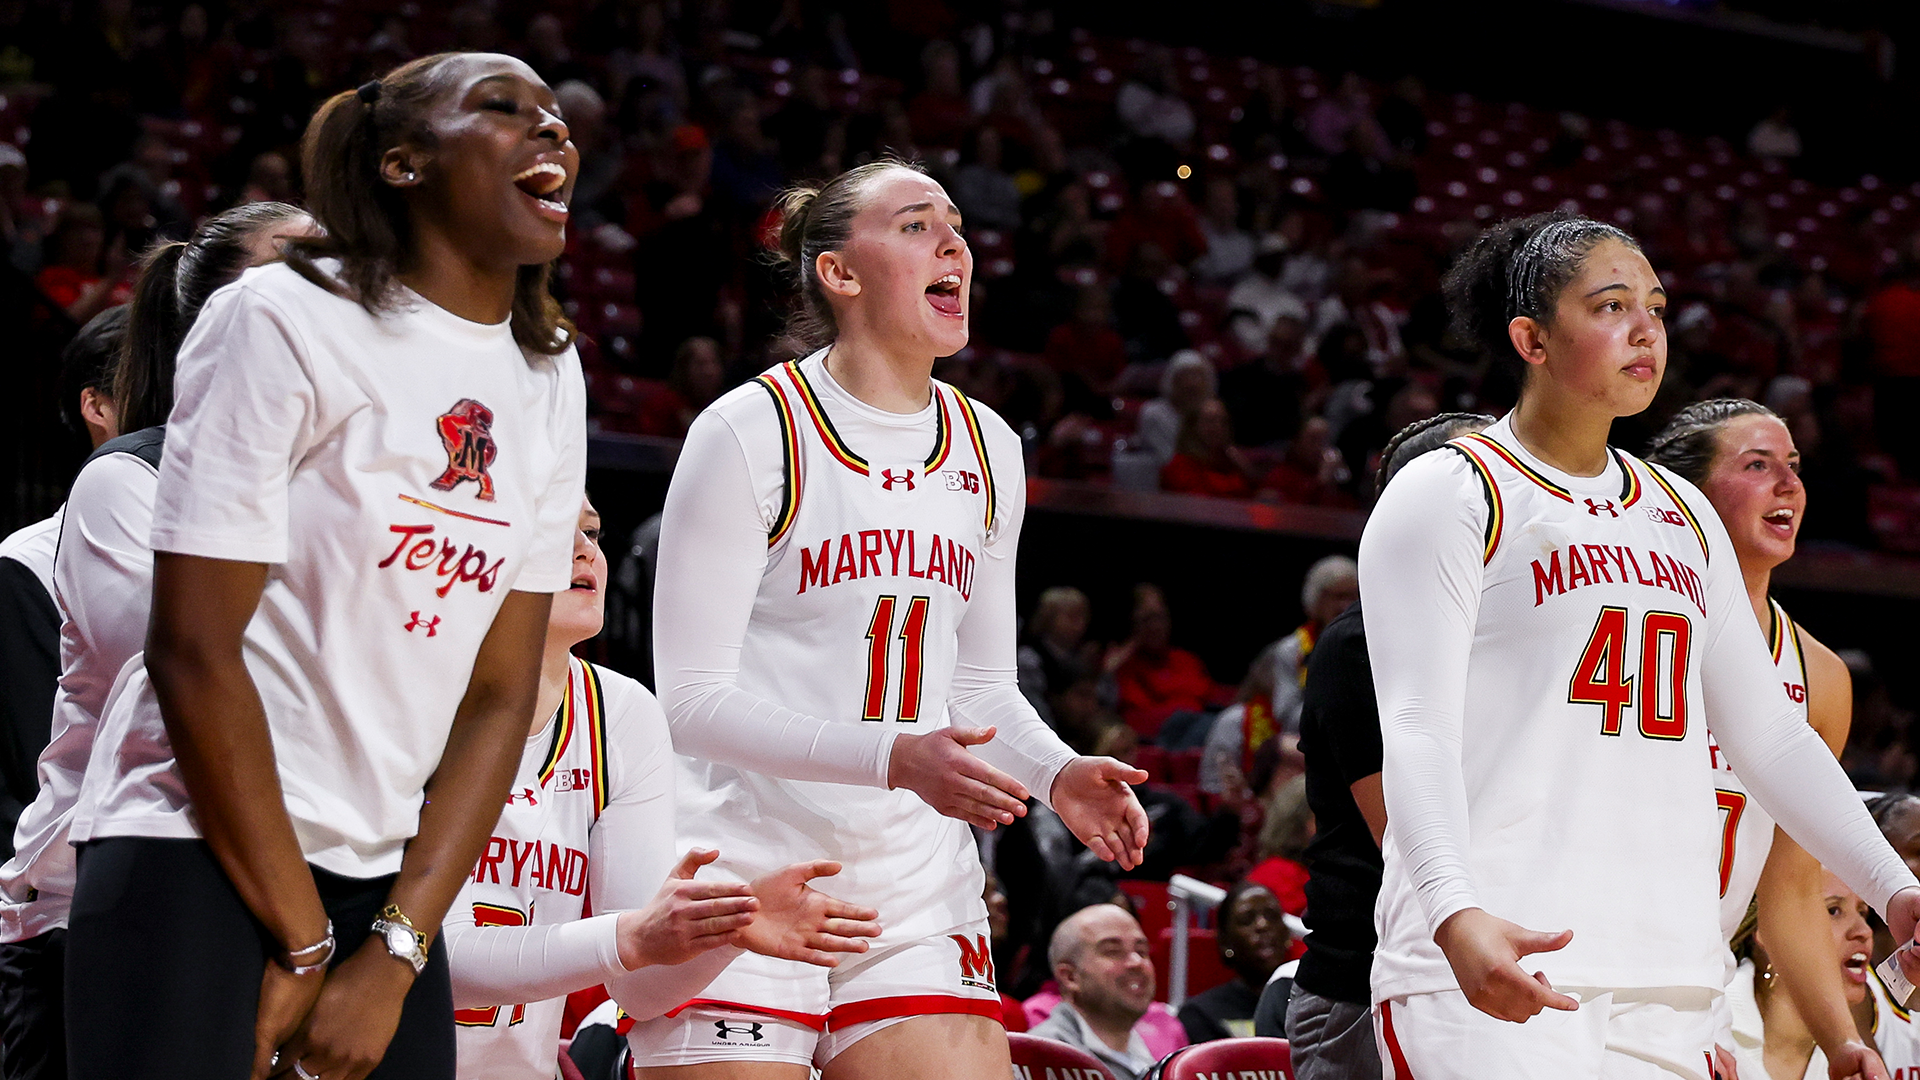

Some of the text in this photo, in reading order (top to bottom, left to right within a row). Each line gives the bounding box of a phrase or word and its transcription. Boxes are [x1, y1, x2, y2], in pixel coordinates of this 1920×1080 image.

[378, 523, 506, 599] Terps
[797, 528, 975, 603] MARYLAND
[1530, 543, 1707, 619] MARYLAND
[861, 594, 930, 723] 11
[1567, 604, 1692, 741] 40
[947, 933, 995, 985] M
